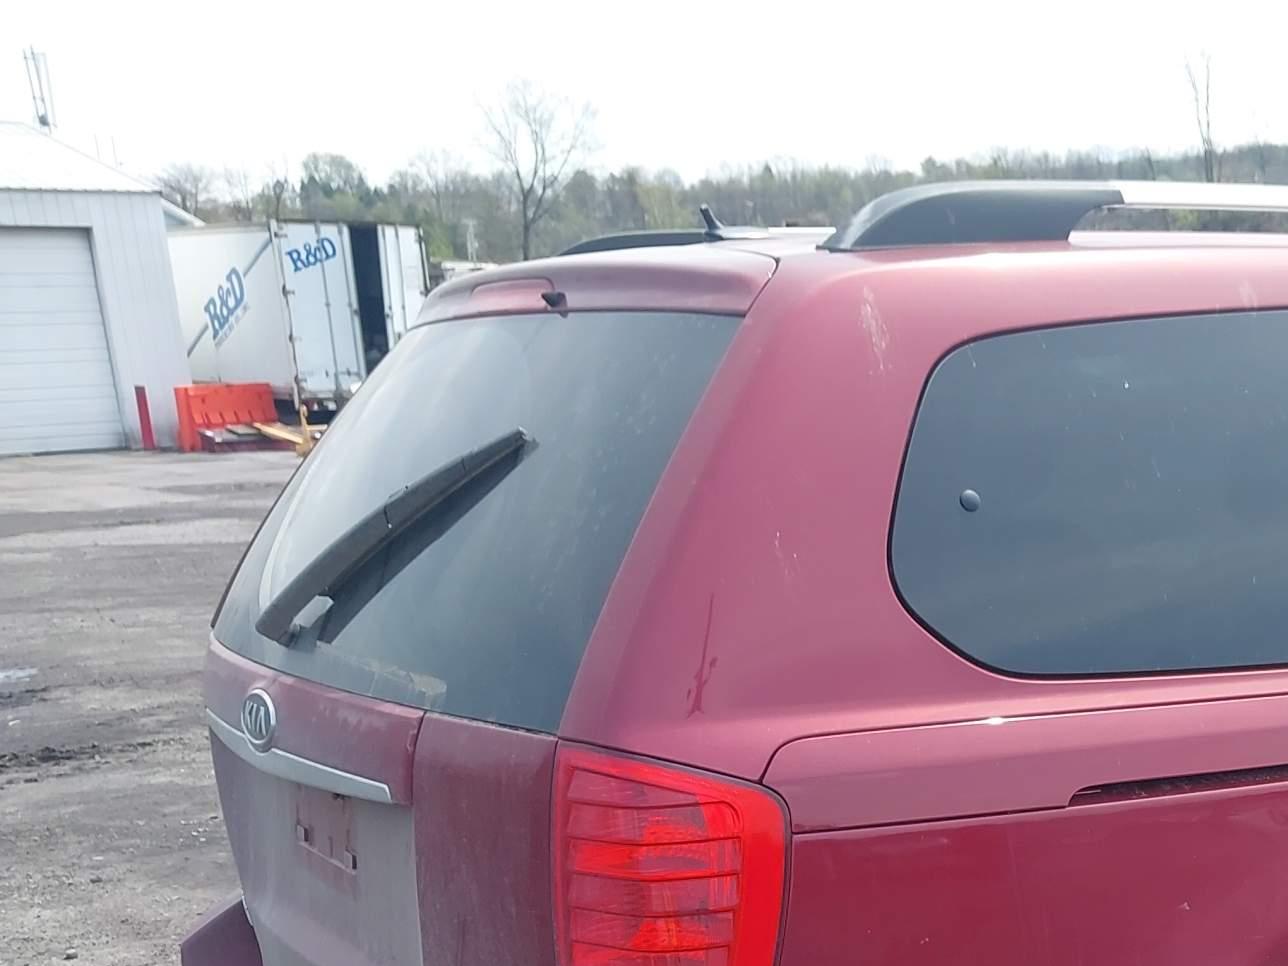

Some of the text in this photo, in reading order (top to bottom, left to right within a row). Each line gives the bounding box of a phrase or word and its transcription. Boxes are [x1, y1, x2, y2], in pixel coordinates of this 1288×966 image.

[286, 237, 337, 273] R&D
[204, 267, 245, 341] R&D
[244, 700, 267, 737] KIA
